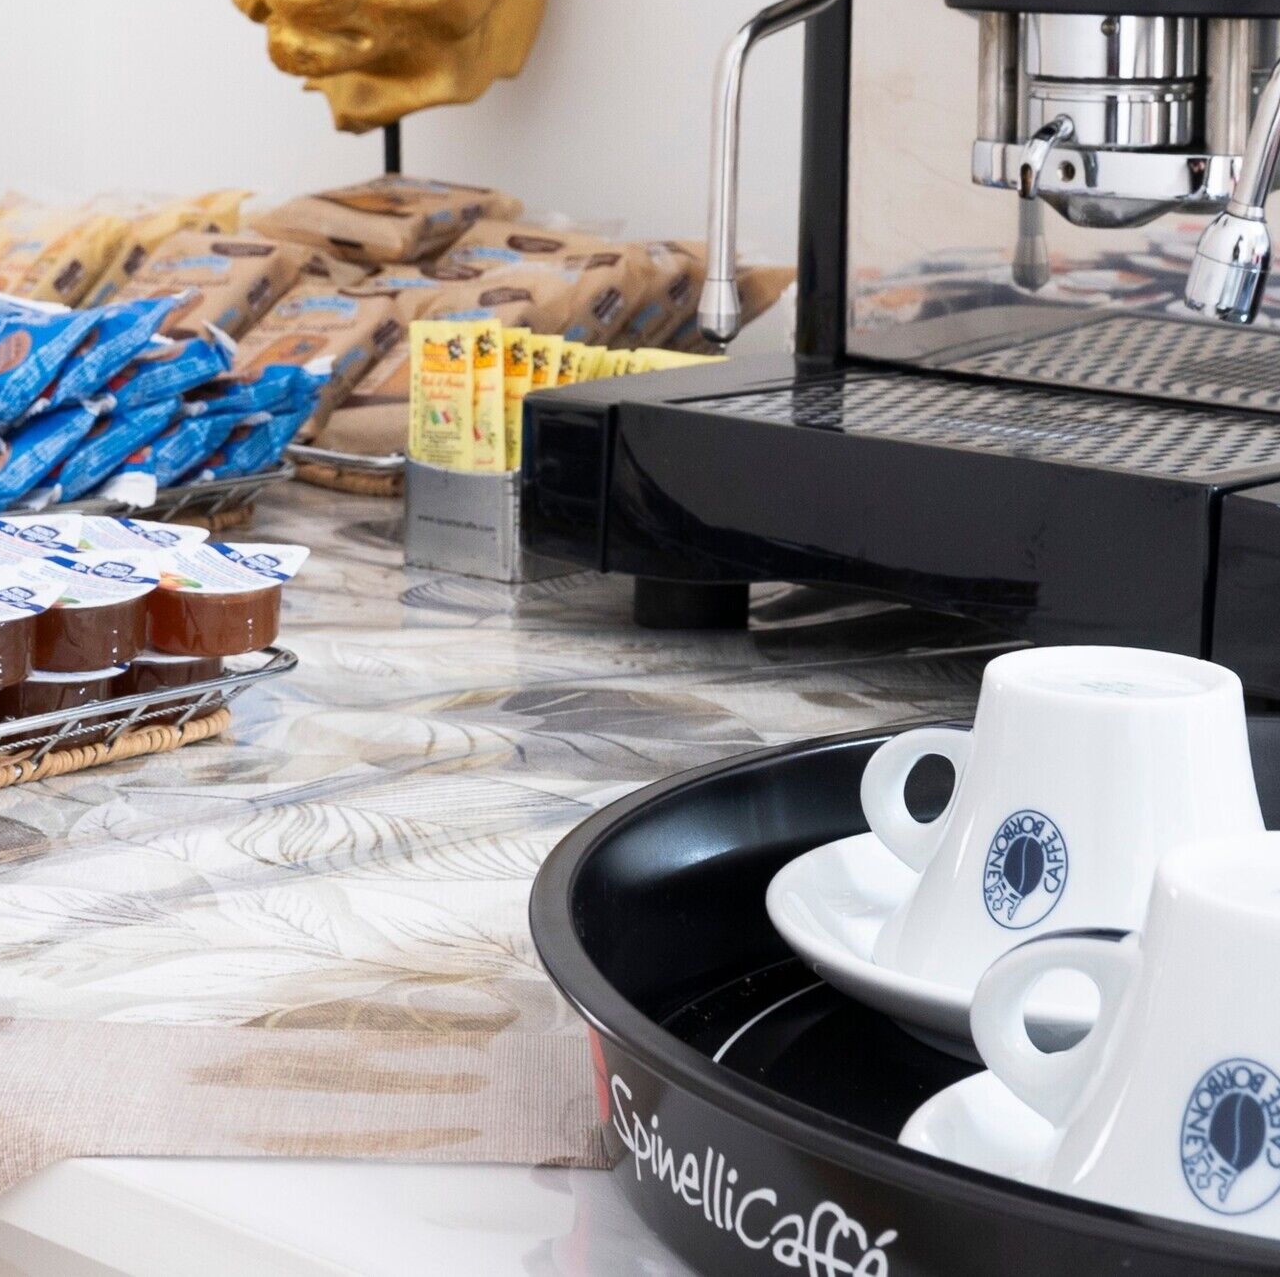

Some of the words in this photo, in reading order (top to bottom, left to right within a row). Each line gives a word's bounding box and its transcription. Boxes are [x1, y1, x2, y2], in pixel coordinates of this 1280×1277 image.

[986, 815, 1046, 880] BORBONE
[1041, 830, 1064, 894] CAFFÈ
[1185, 1065, 1268, 1146] BORBONE
